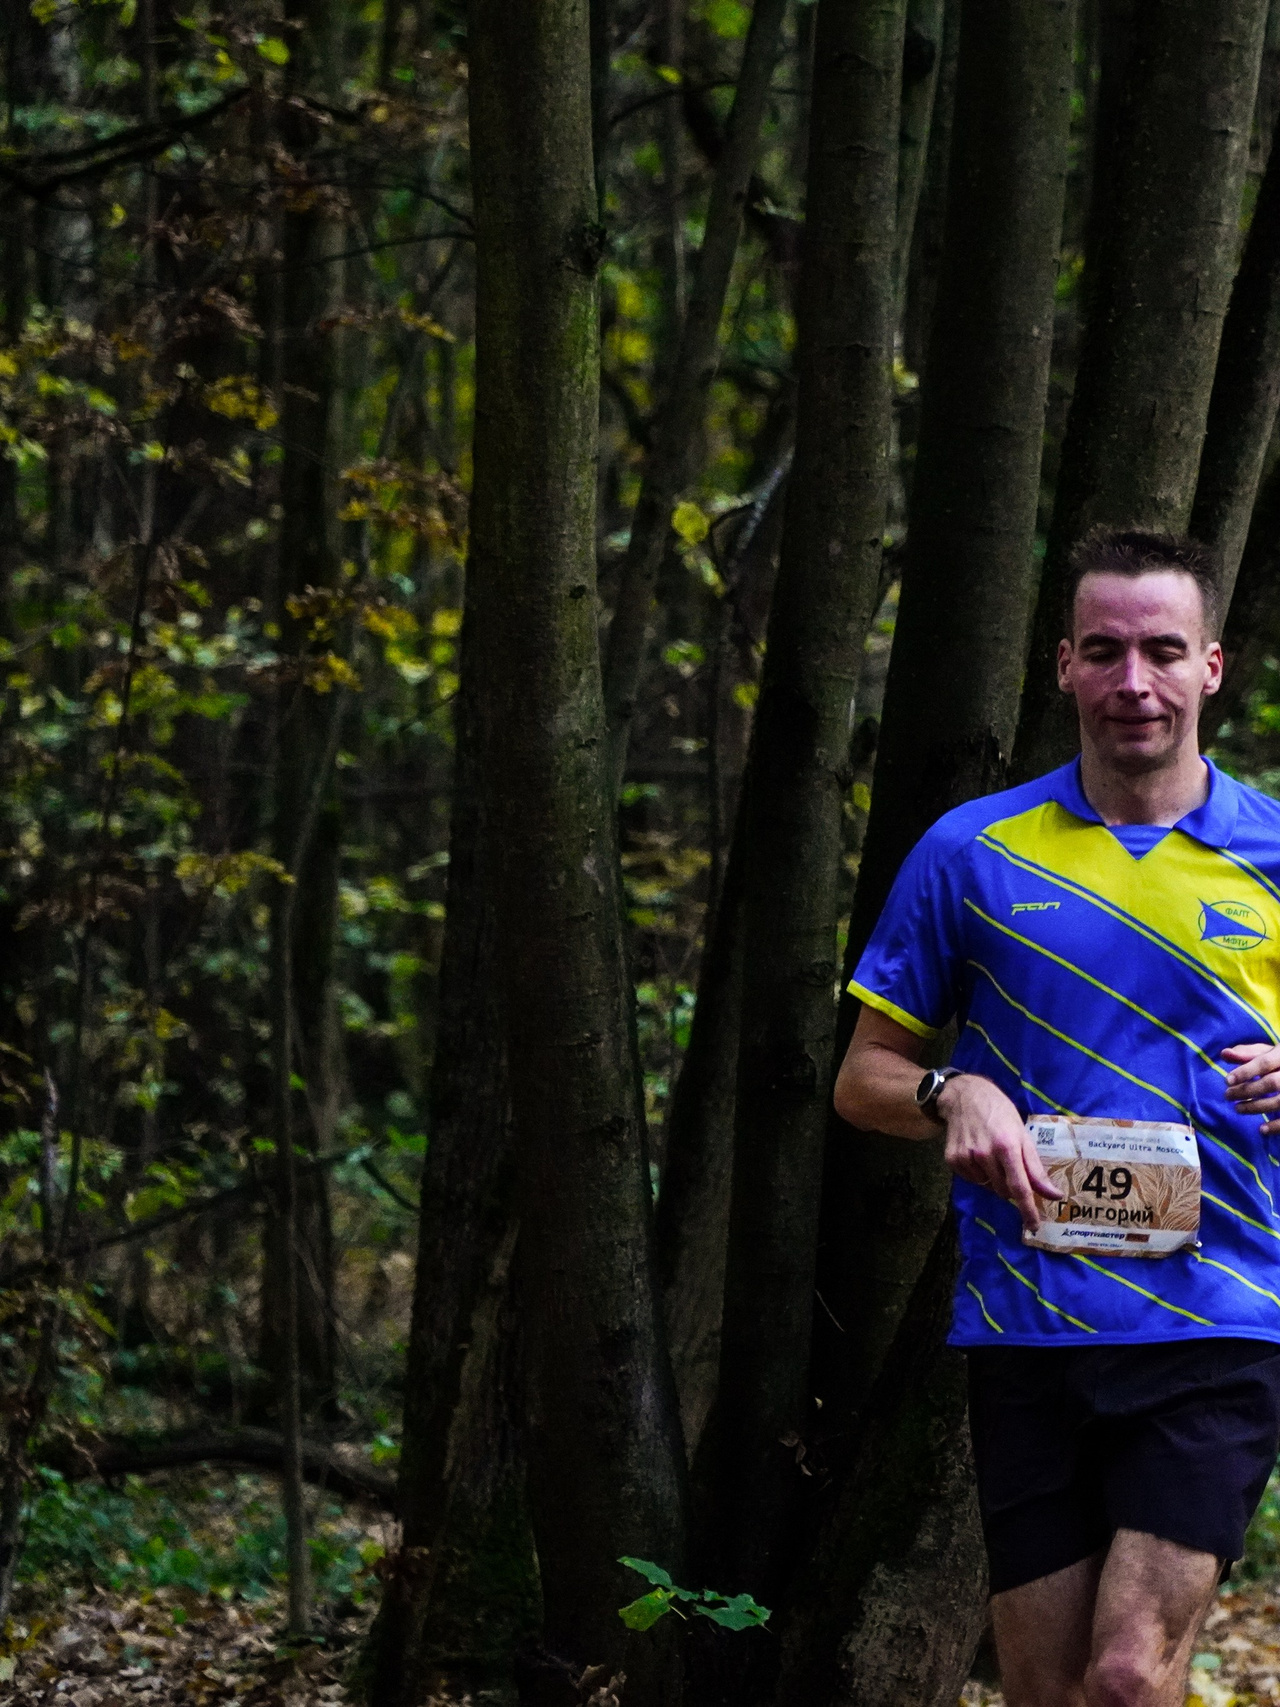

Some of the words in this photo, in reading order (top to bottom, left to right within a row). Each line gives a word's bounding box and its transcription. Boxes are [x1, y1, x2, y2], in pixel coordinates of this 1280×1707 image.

[1225, 907, 1250, 919] ФАЛТ
[1222, 935, 1249, 948] МФТИ
[1088, 1140, 1126, 1150] Backyard
[1129, 1144, 1152, 1152] Ultra
[1082, 1166, 1133, 1200] 49
[1058, 1201, 1154, 1225] Григорий
